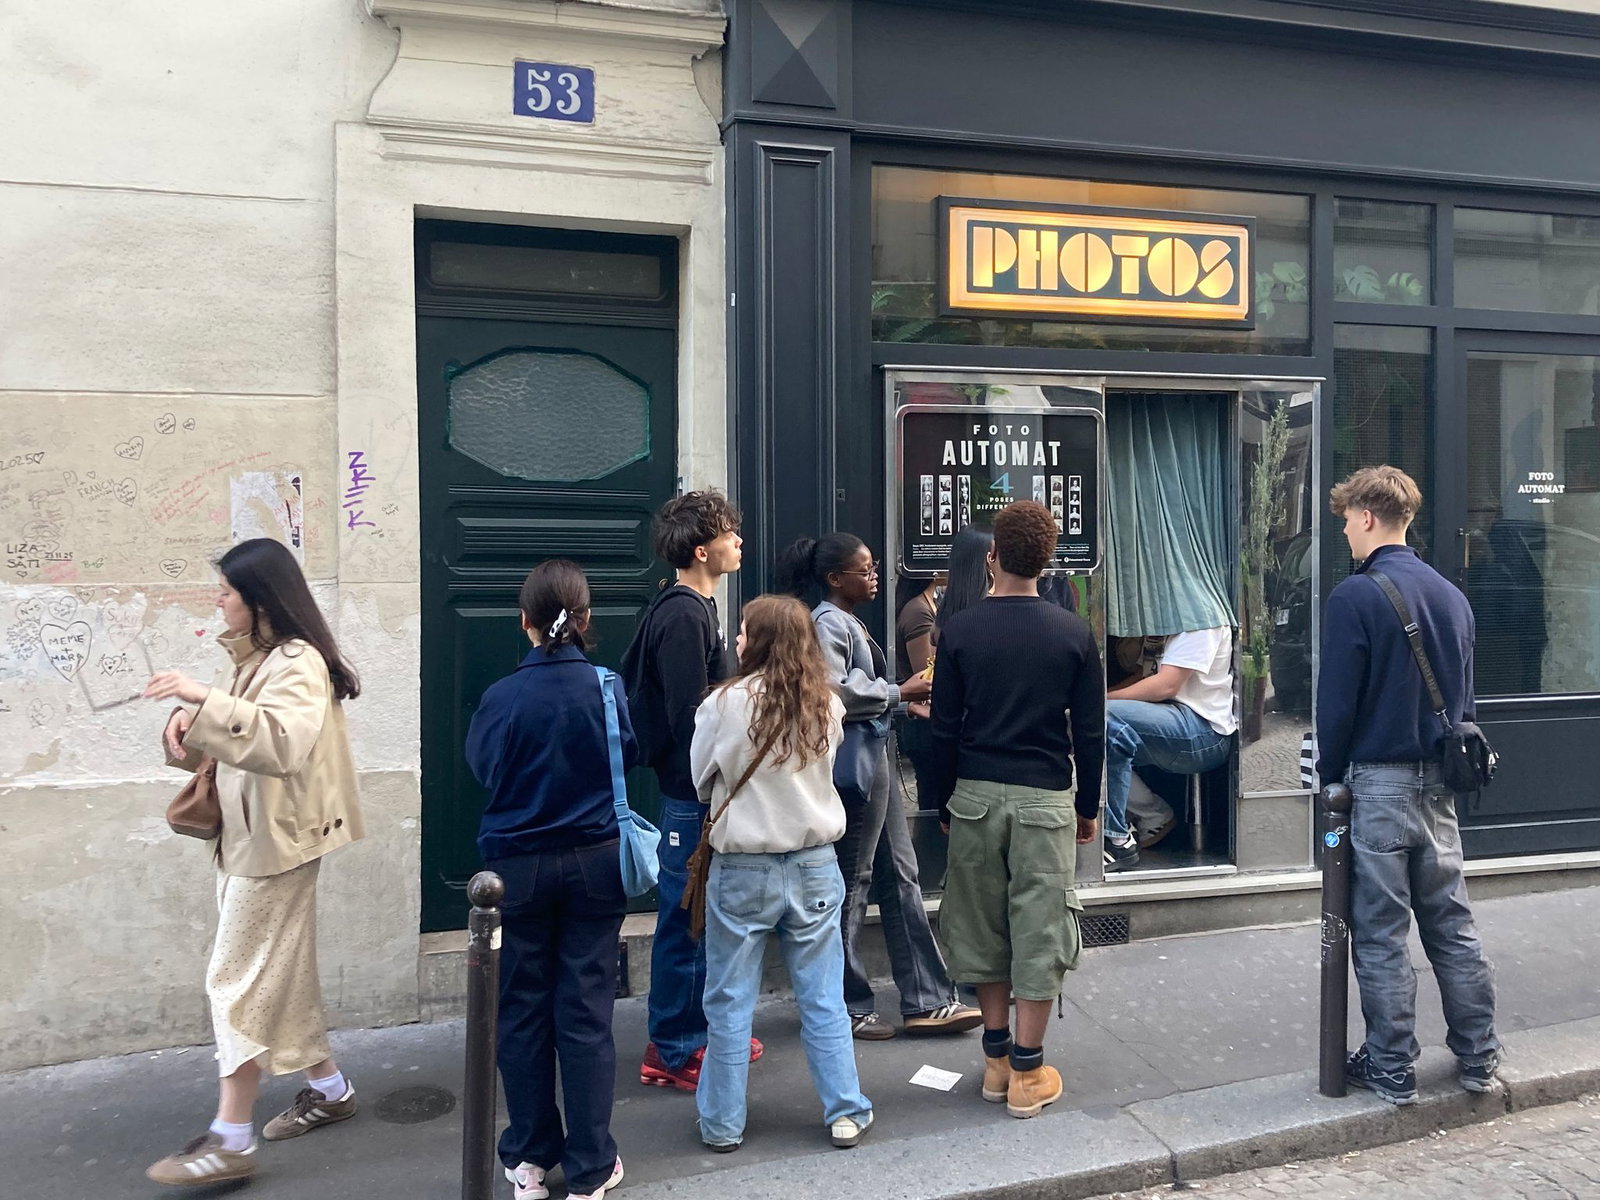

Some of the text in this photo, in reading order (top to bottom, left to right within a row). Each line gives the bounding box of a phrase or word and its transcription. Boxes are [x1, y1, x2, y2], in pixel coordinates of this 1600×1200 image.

[527, 69, 581, 115] 53
[972, 226, 1234, 299] PHOTOS
[973, 424, 1031, 435] FOTO
[942, 440, 1061, 466] AUTOMAT
[990, 472, 1014, 493] 4
[1528, 472, 1554, 480] FOTO
[1517, 484, 1565, 493] AUTOMAT
[6, 544, 38, 554] LIZA
